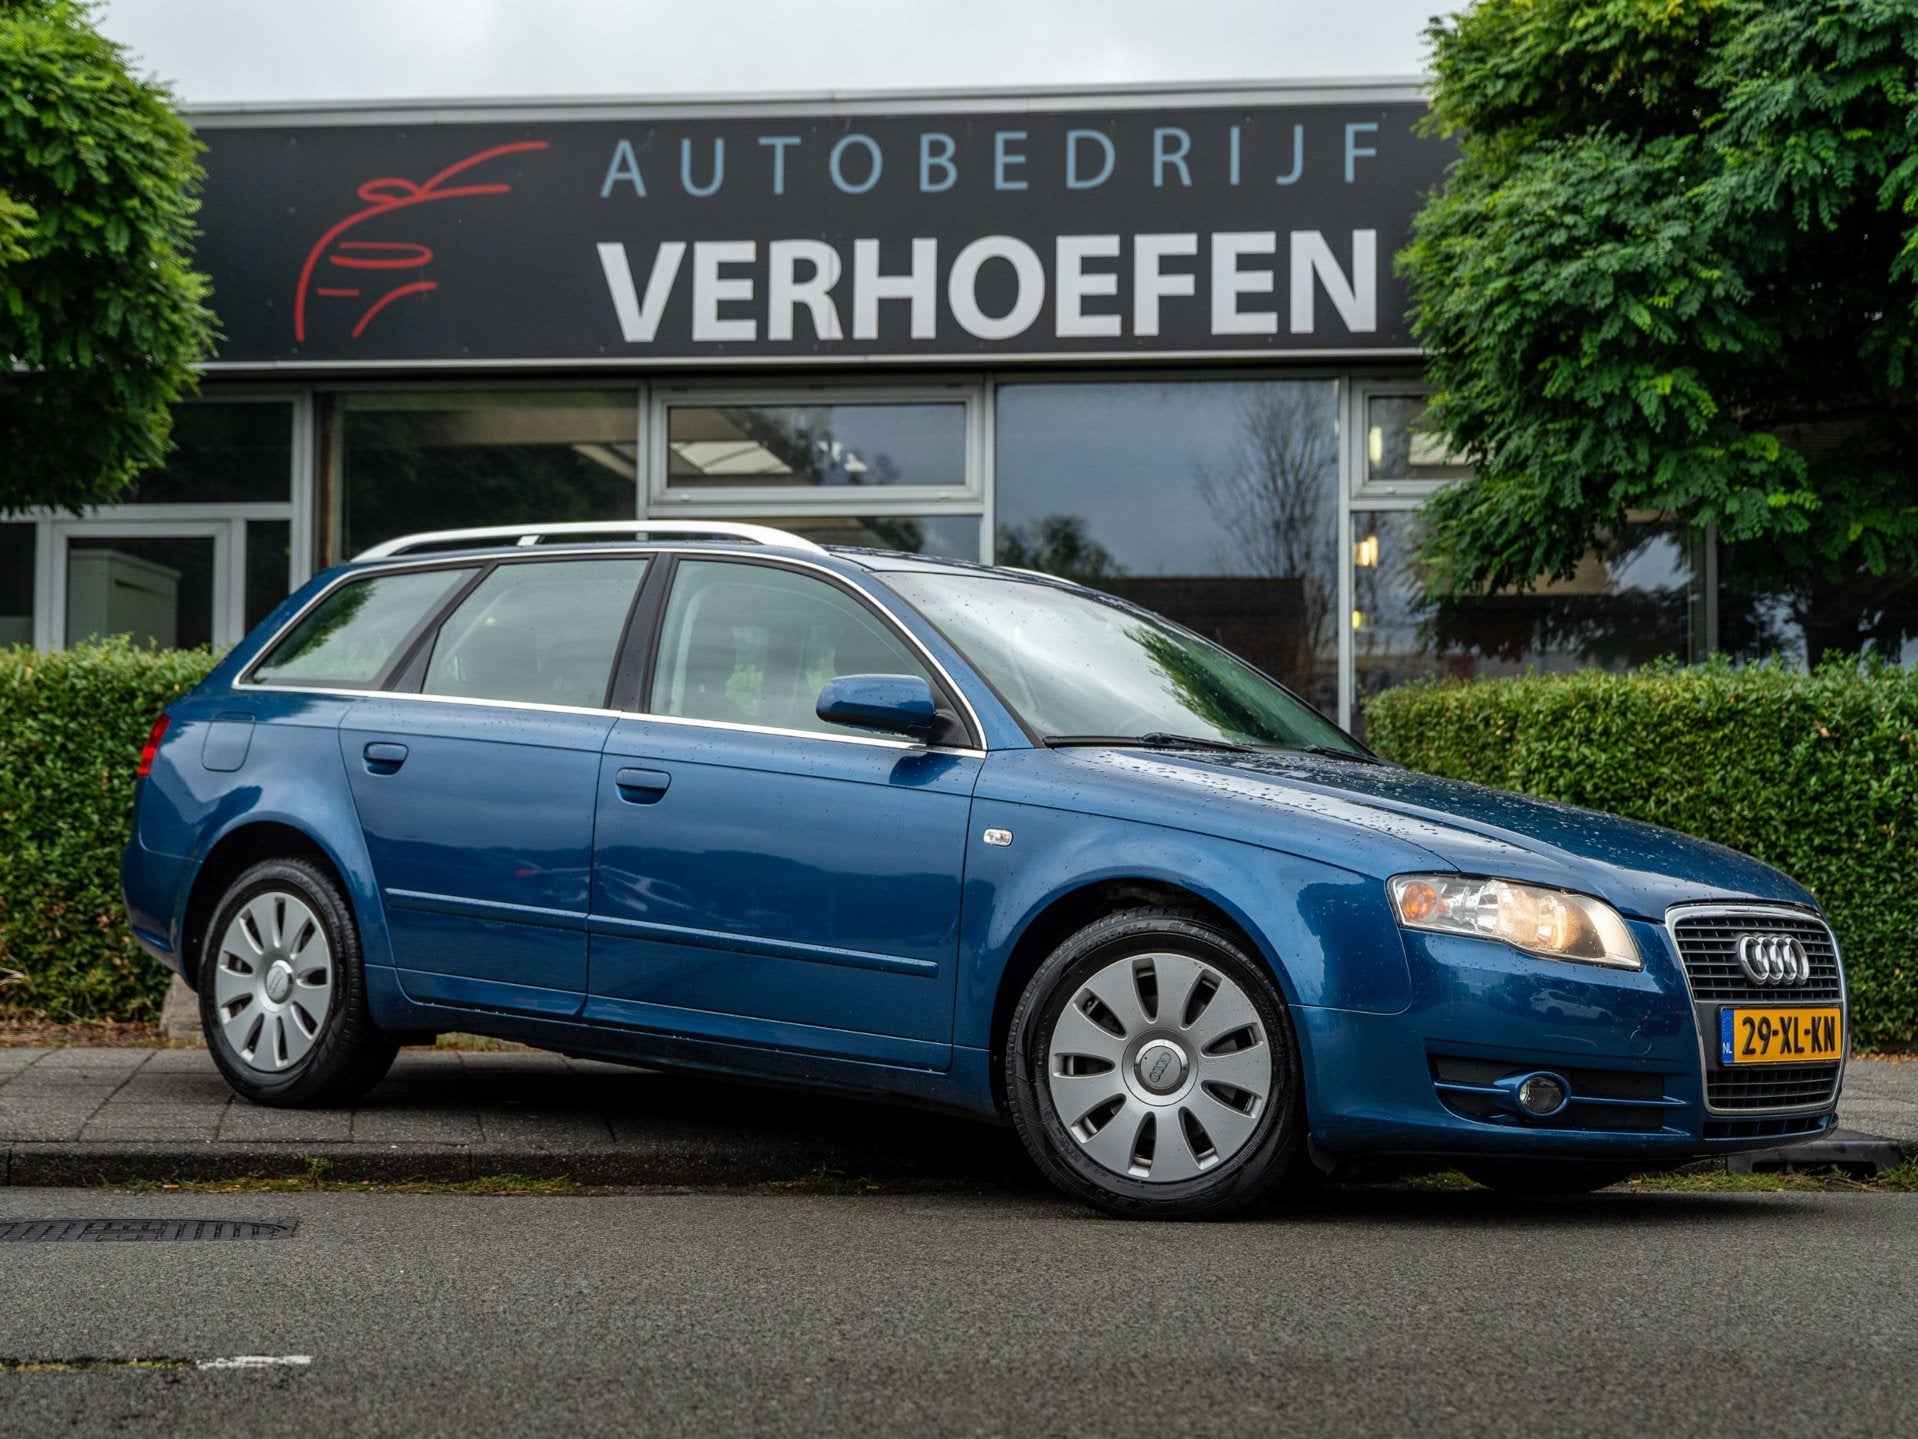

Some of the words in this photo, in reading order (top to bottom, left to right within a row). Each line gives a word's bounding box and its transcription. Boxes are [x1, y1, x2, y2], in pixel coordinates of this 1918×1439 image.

[600, 121, 1380, 198] AUTOBEDRIJF
[596, 228, 1378, 344] VERHOEFEN
[1722, 1042, 1733, 1054] NL
[1742, 1016, 1836, 1055] 29-XL-KN
